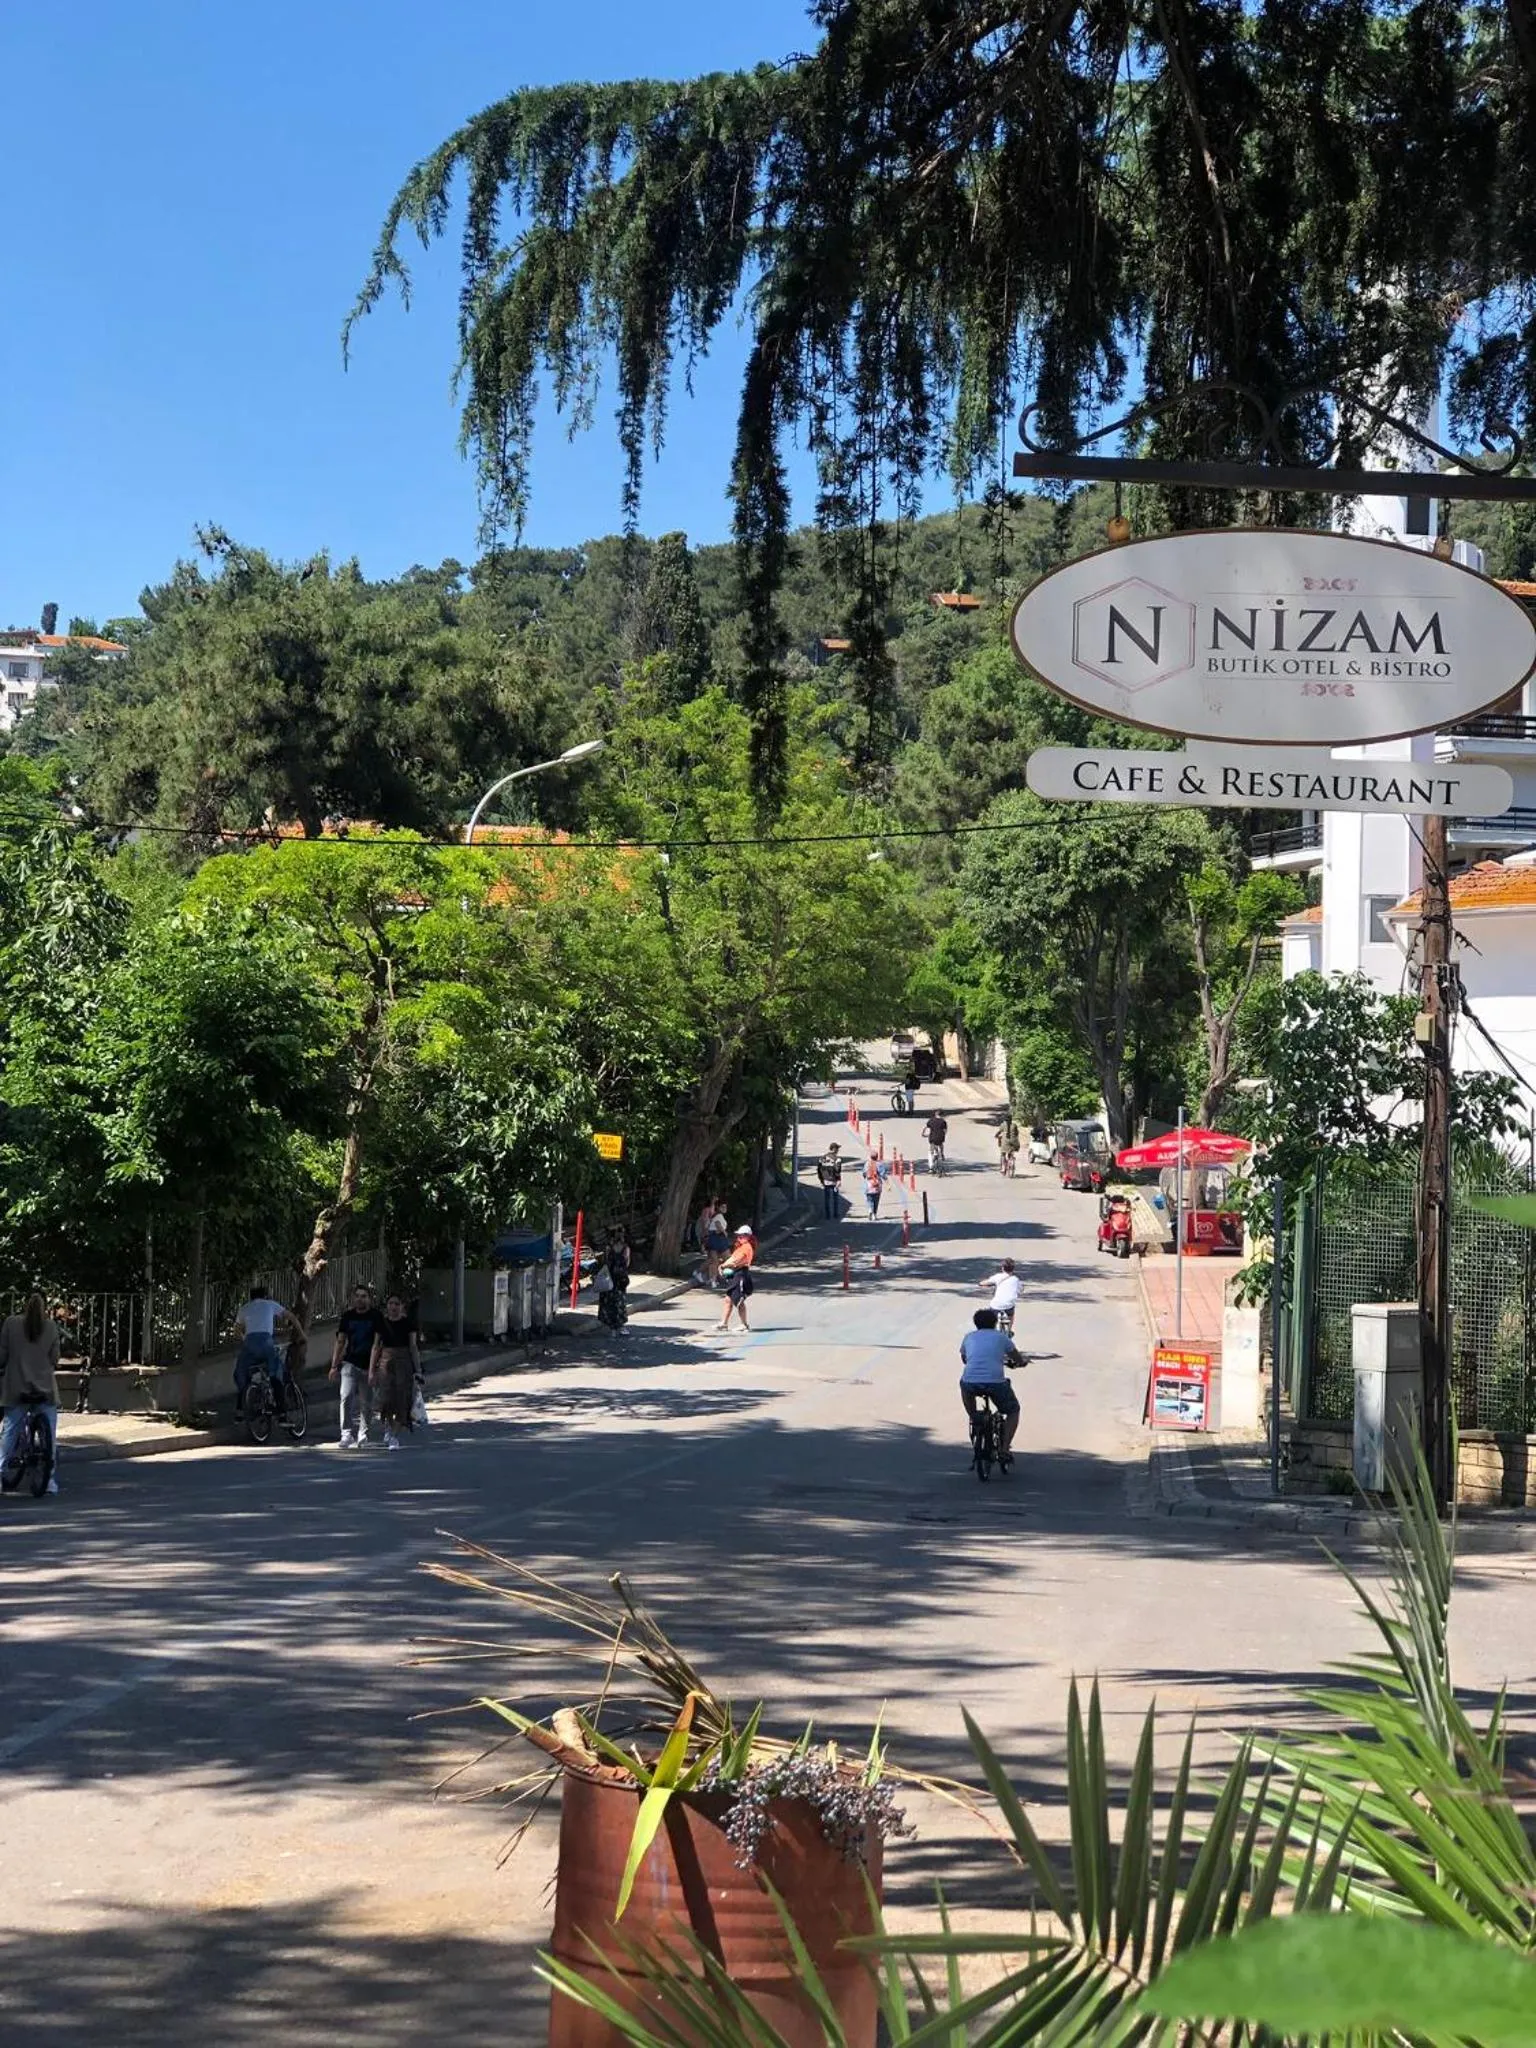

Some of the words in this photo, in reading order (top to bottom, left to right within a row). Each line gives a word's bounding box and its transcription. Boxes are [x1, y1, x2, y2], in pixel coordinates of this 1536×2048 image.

[1101, 604, 1167, 665] N
[1208, 598, 1453, 655] NİZAM
[1207, 655, 1278, 674] BUTİK
[1283, 659, 1341, 676] OTEL
[1346, 660, 1363, 676] &
[1370, 658, 1452, 678] BİSTRO
[1177, 764, 1208, 795] &
